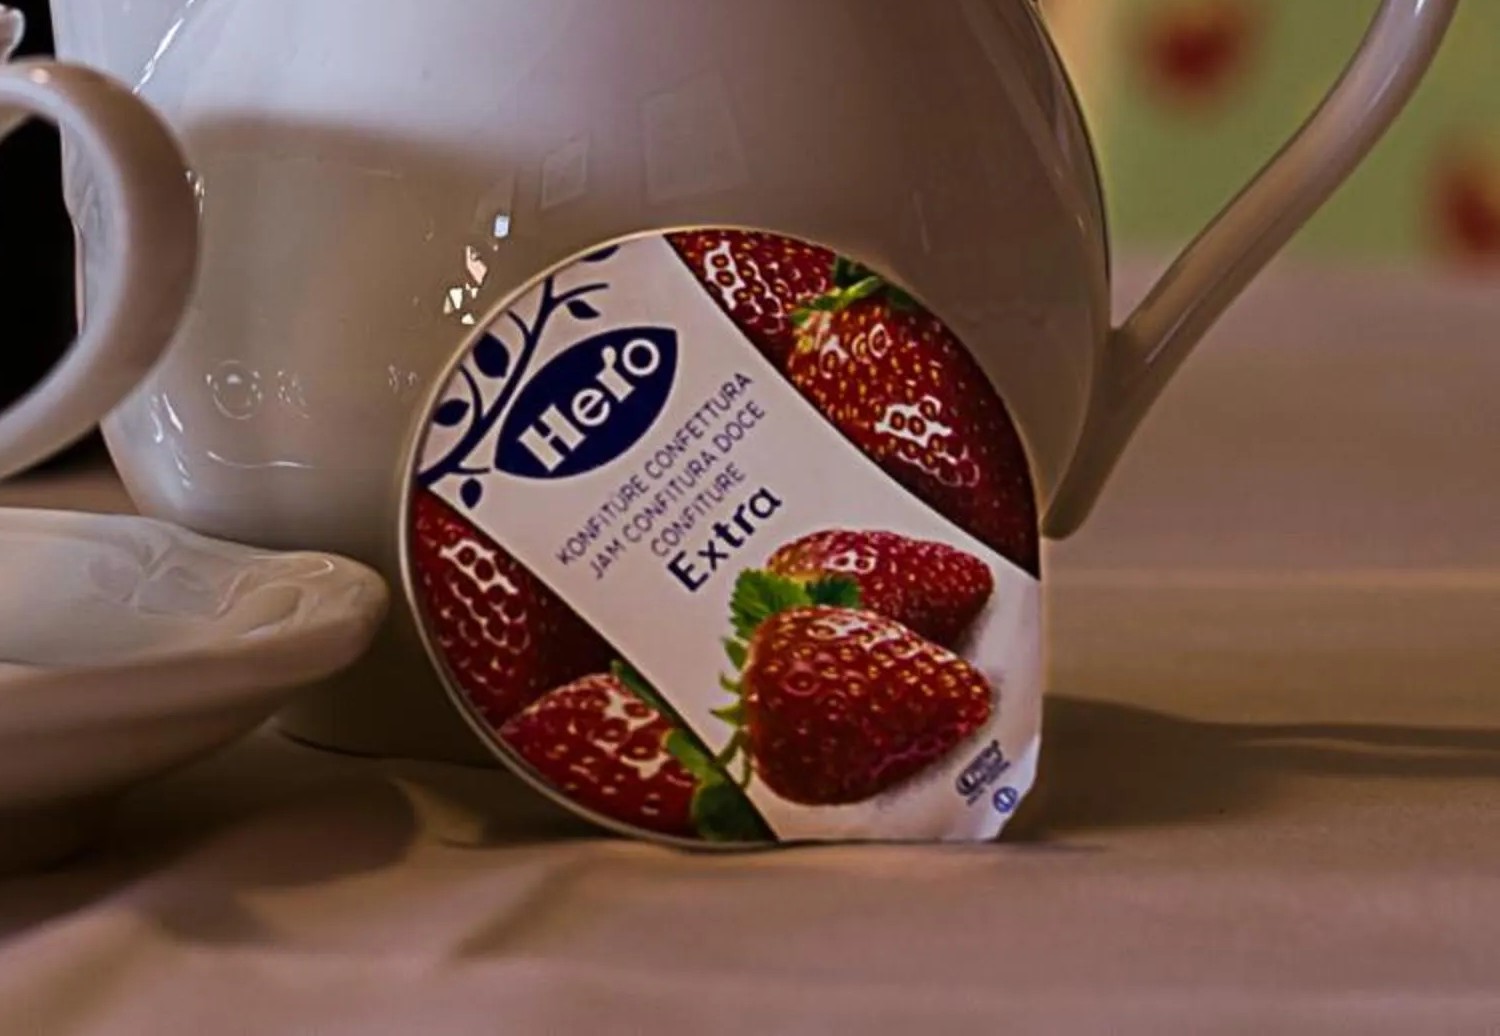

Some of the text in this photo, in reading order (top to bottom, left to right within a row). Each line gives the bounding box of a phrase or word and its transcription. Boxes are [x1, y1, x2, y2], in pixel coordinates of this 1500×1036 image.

[517, 338, 660, 471] Hero
[645, 372, 752, 479] CONFETTURA
[589, 400, 765, 580] JAM CONFITURA DOCE
[651, 462, 746, 557] CONFITURE
[667, 487, 782, 592] Extra
